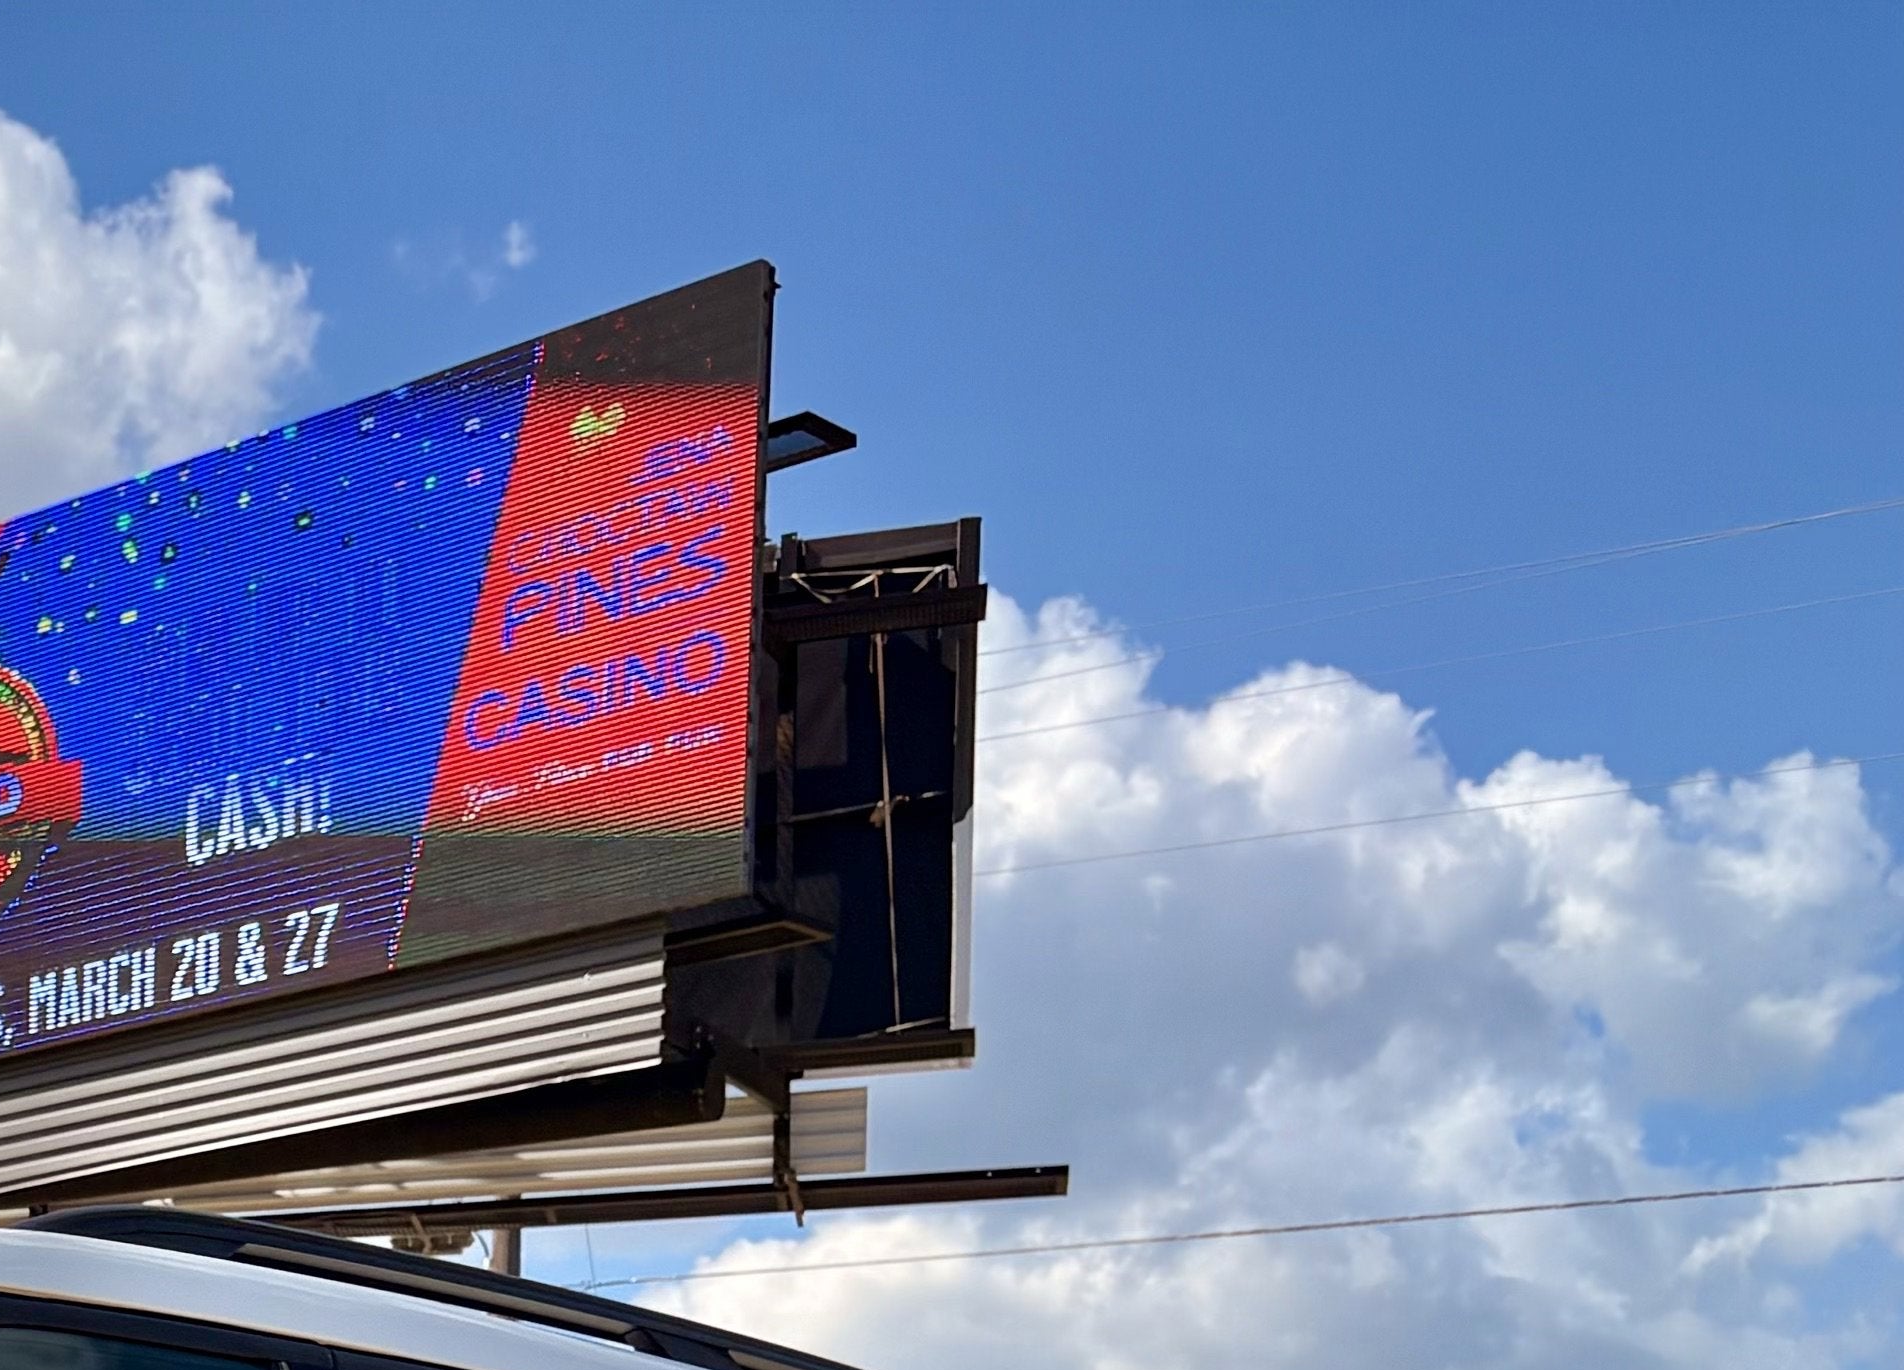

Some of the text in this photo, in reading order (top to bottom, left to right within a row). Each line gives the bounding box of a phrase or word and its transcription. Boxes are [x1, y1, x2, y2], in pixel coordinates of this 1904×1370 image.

[508, 472, 735, 574] CHOCTAW
[500, 523, 727, 654] PINES
[464, 629, 727, 751] CASINO
[186, 753, 334, 866] CASH!
[29, 947, 155, 1034] MARCH
[171, 933, 220, 1002] 20
[235, 921, 267, 985] &
[283, 903, 340, 976] 27
